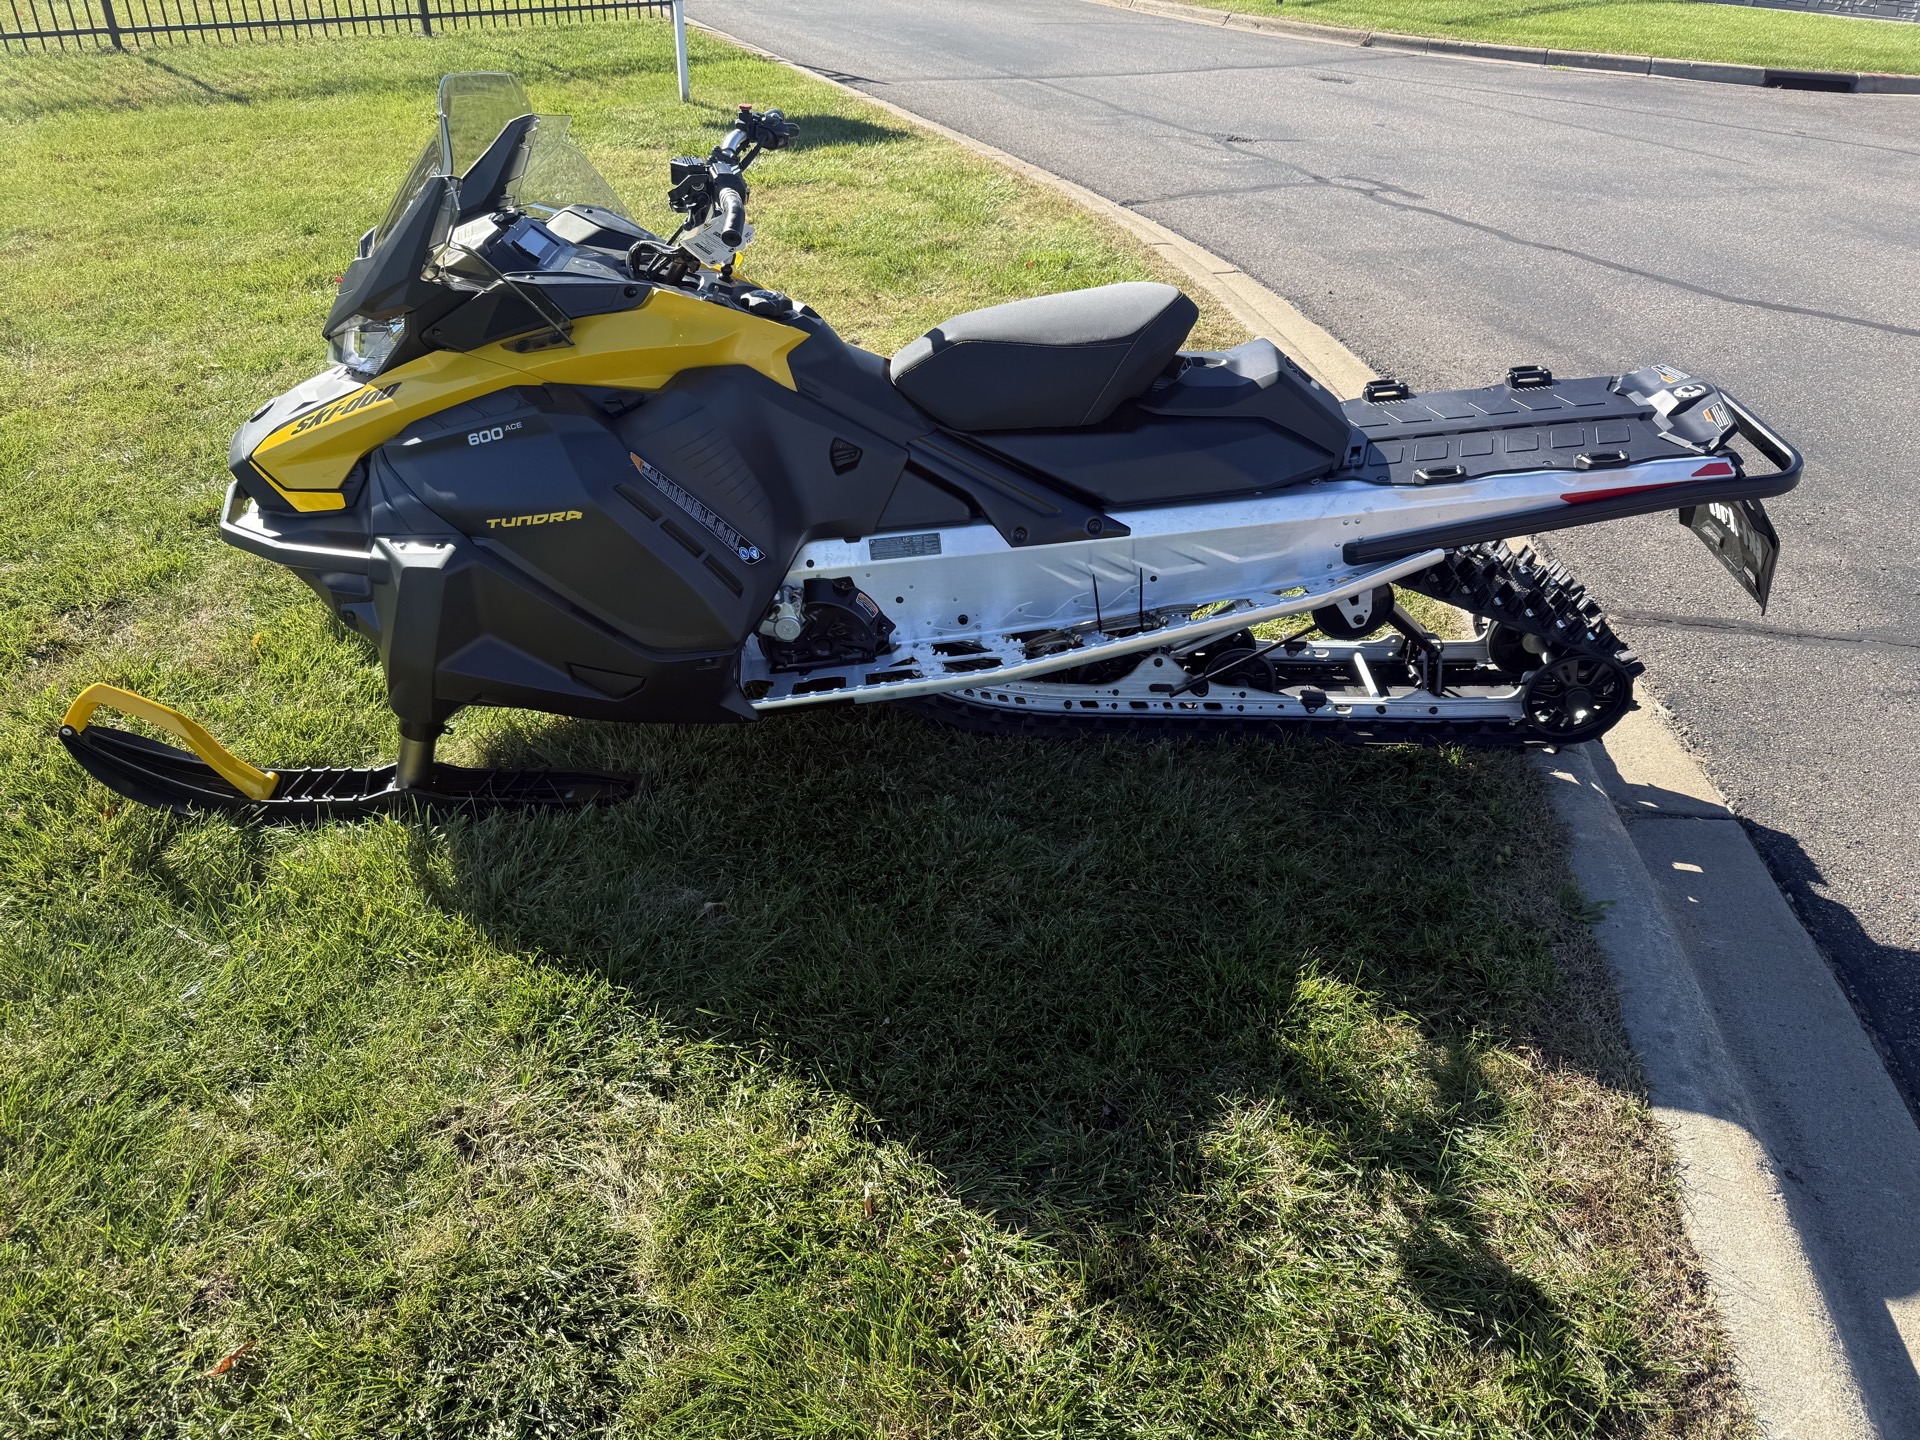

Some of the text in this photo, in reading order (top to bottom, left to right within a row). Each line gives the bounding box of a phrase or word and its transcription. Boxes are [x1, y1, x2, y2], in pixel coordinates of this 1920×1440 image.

[291, 382, 402, 435] ski-doo
[468, 421, 522, 446] 600 ACE
[486, 510, 583, 528] TUNDRA
